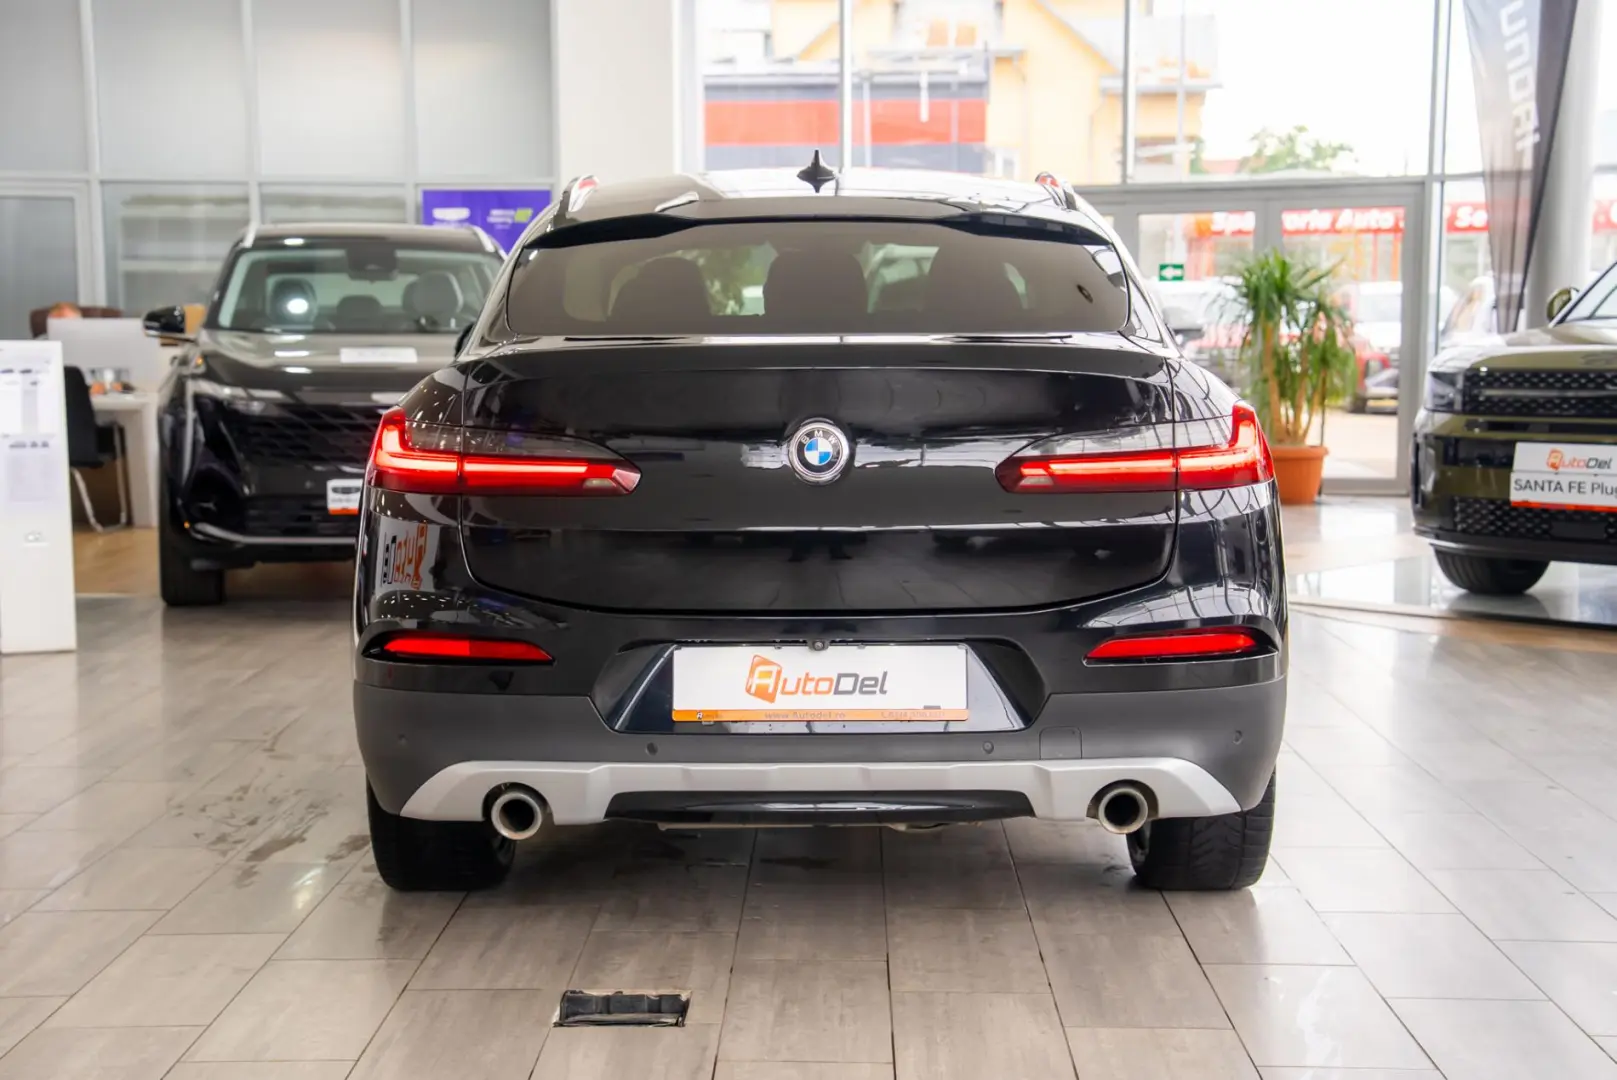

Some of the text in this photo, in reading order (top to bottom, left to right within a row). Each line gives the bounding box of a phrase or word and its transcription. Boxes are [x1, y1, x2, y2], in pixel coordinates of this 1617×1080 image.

[1335, 208, 1395, 229] Auto
[801, 430, 836, 444] BMW
[1545, 448, 1613, 471] AutoDel
[1513, 478, 1564, 494] SANTA
[1568, 480, 1587, 495] FE
[746, 656, 888, 702] AutoDel
